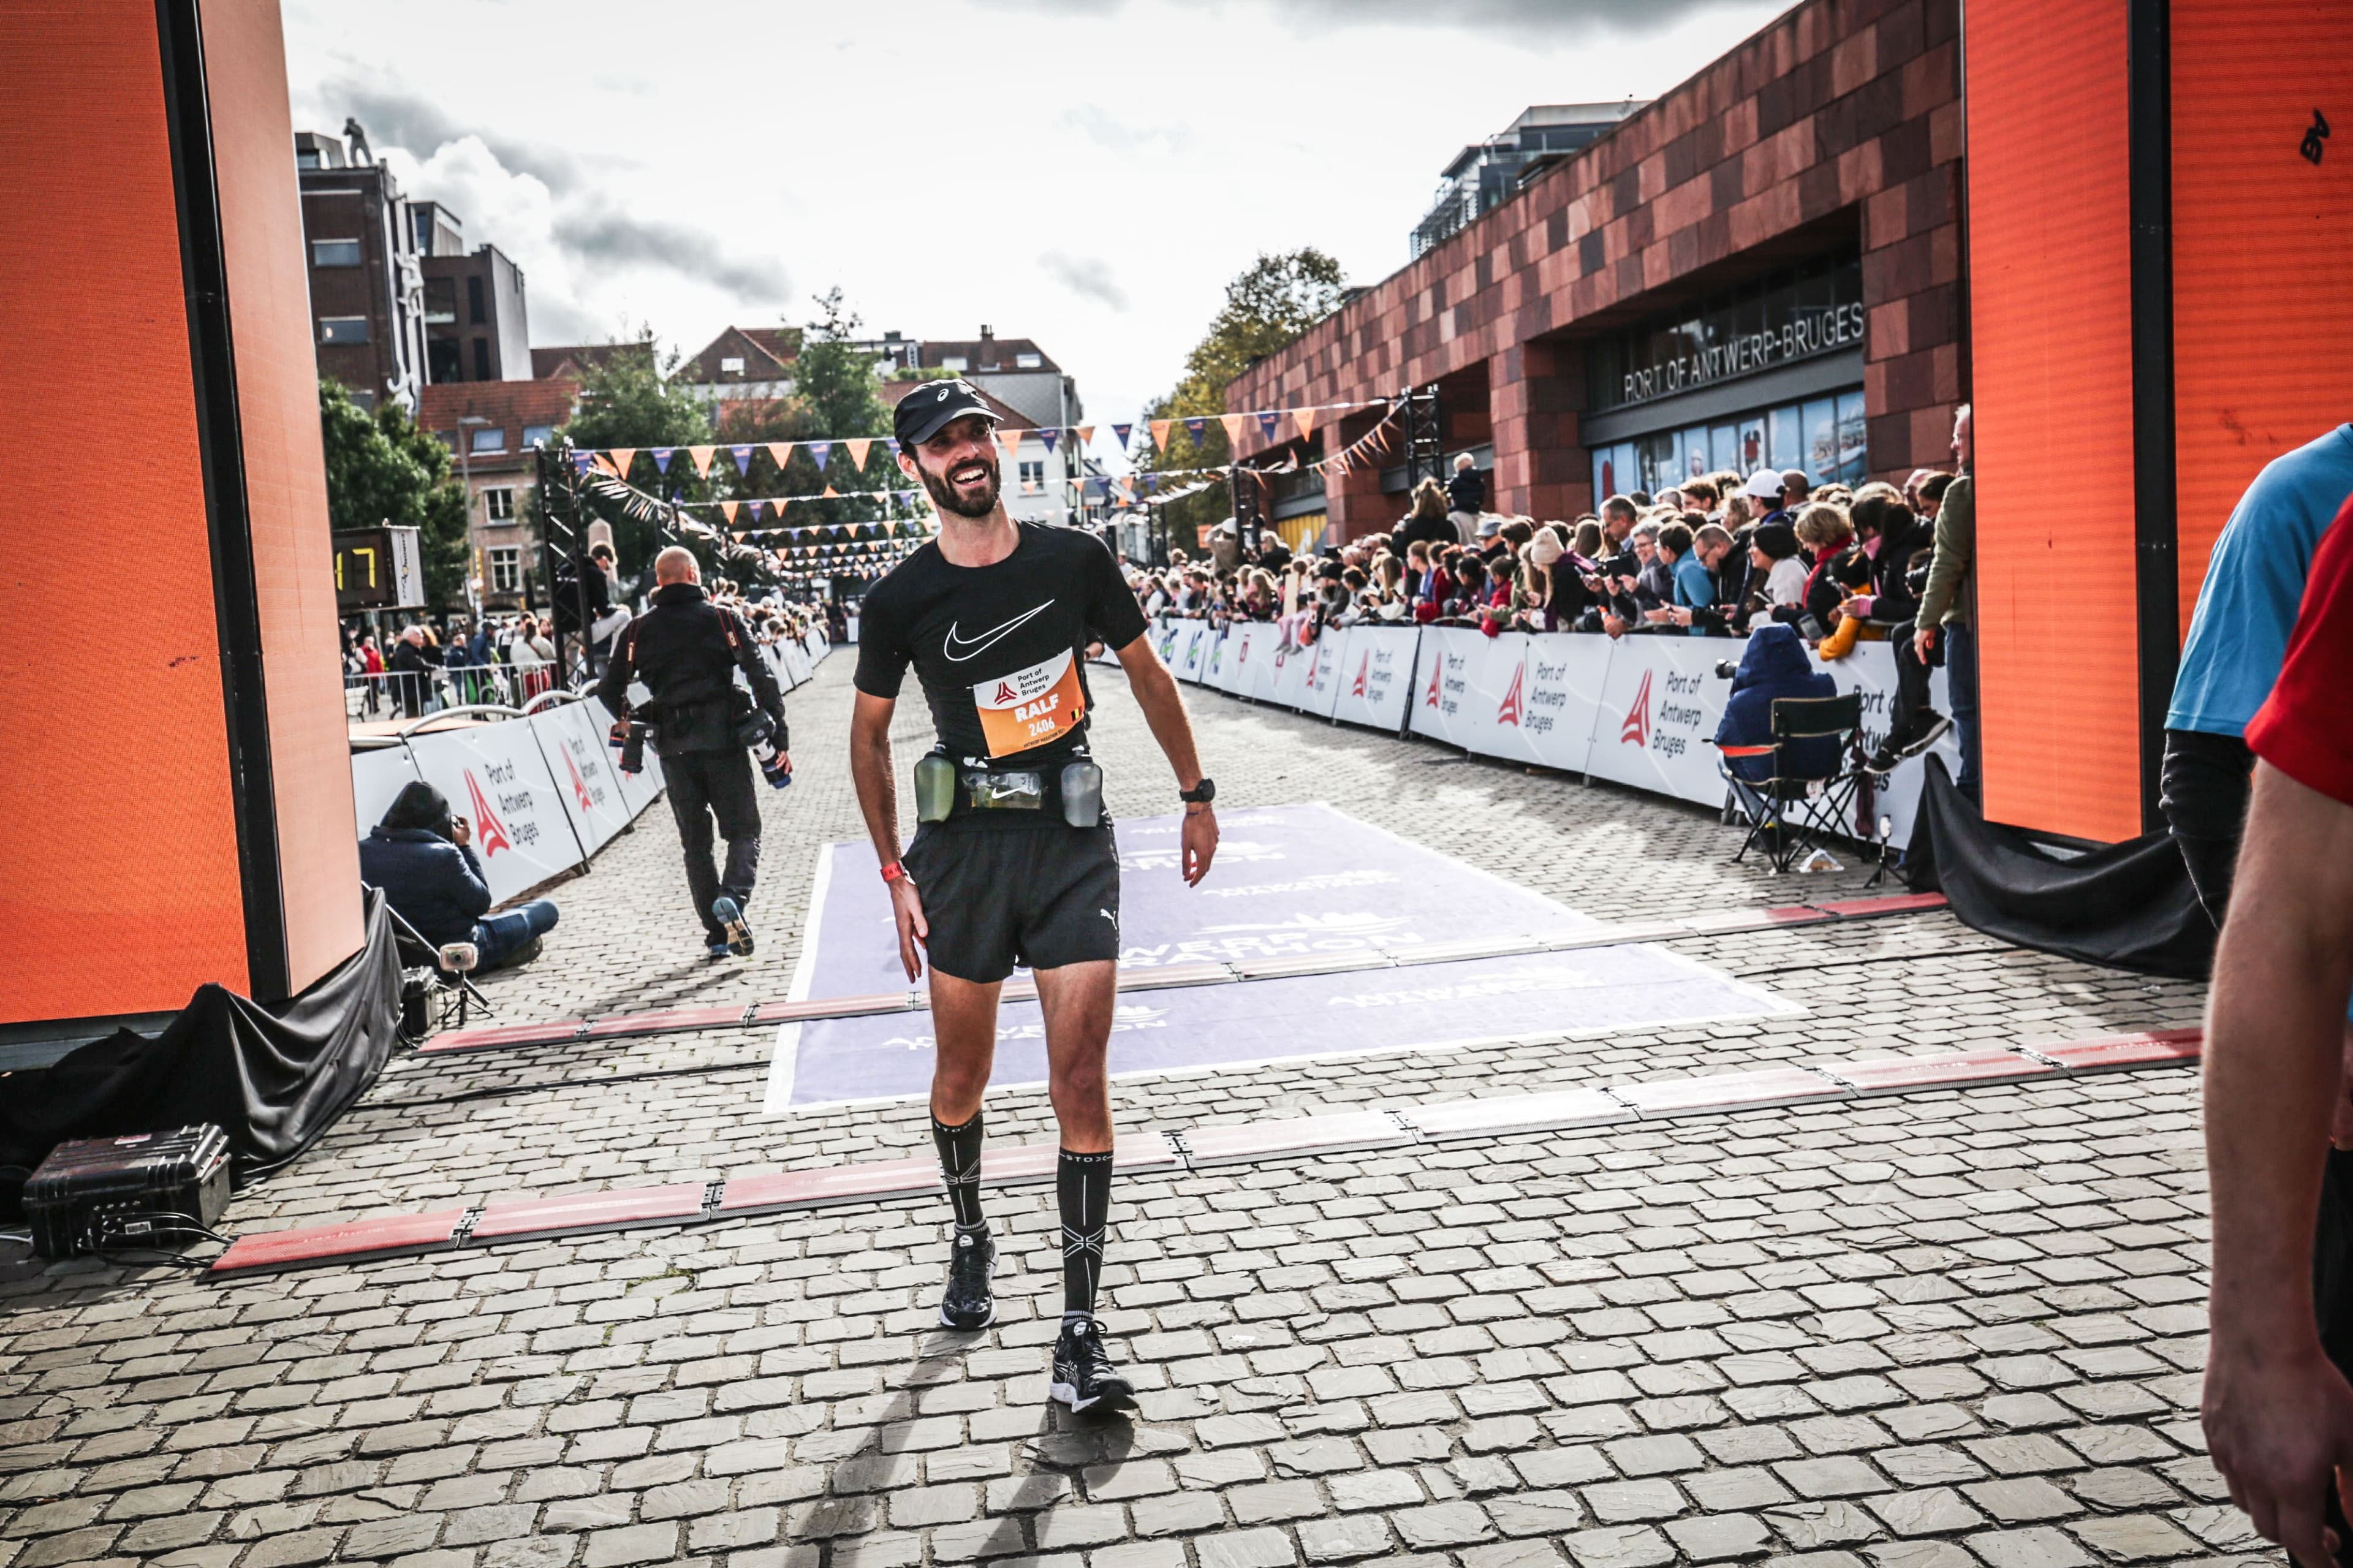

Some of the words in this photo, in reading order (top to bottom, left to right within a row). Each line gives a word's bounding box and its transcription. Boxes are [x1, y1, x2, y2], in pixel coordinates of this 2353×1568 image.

[1624, 365, 1662, 403] PORT
[1667, 358, 1686, 390] OF
[1691, 302, 1863, 384] ANTWERP-BRUGES
[1018, 673, 1033, 681] Port
[1020, 675, 1049, 689] Antwerp
[1536, 662, 1553, 680] Port
[1556, 663, 1566, 681] of
[1666, 671, 1687, 694] Port
[1689, 673, 1702, 695] of
[1021, 684, 1045, 696] Bruges
[1530, 686, 1566, 712] Antwerp
[1014, 694, 1059, 722] RALF
[1658, 700, 1702, 732] Antwerp
[1029, 716, 1055, 737] 2406
[1525, 710, 1553, 735] Bruges
[1653, 729, 1686, 758] Bruges
[485, 763, 507, 786] Port
[506, 758, 515, 780] of
[498, 792, 533, 816] Antwerp
[509, 822, 539, 846] Bruges
[1119, 932, 1425, 968] RATHON
[1120, 932, 1309, 958] WERP
